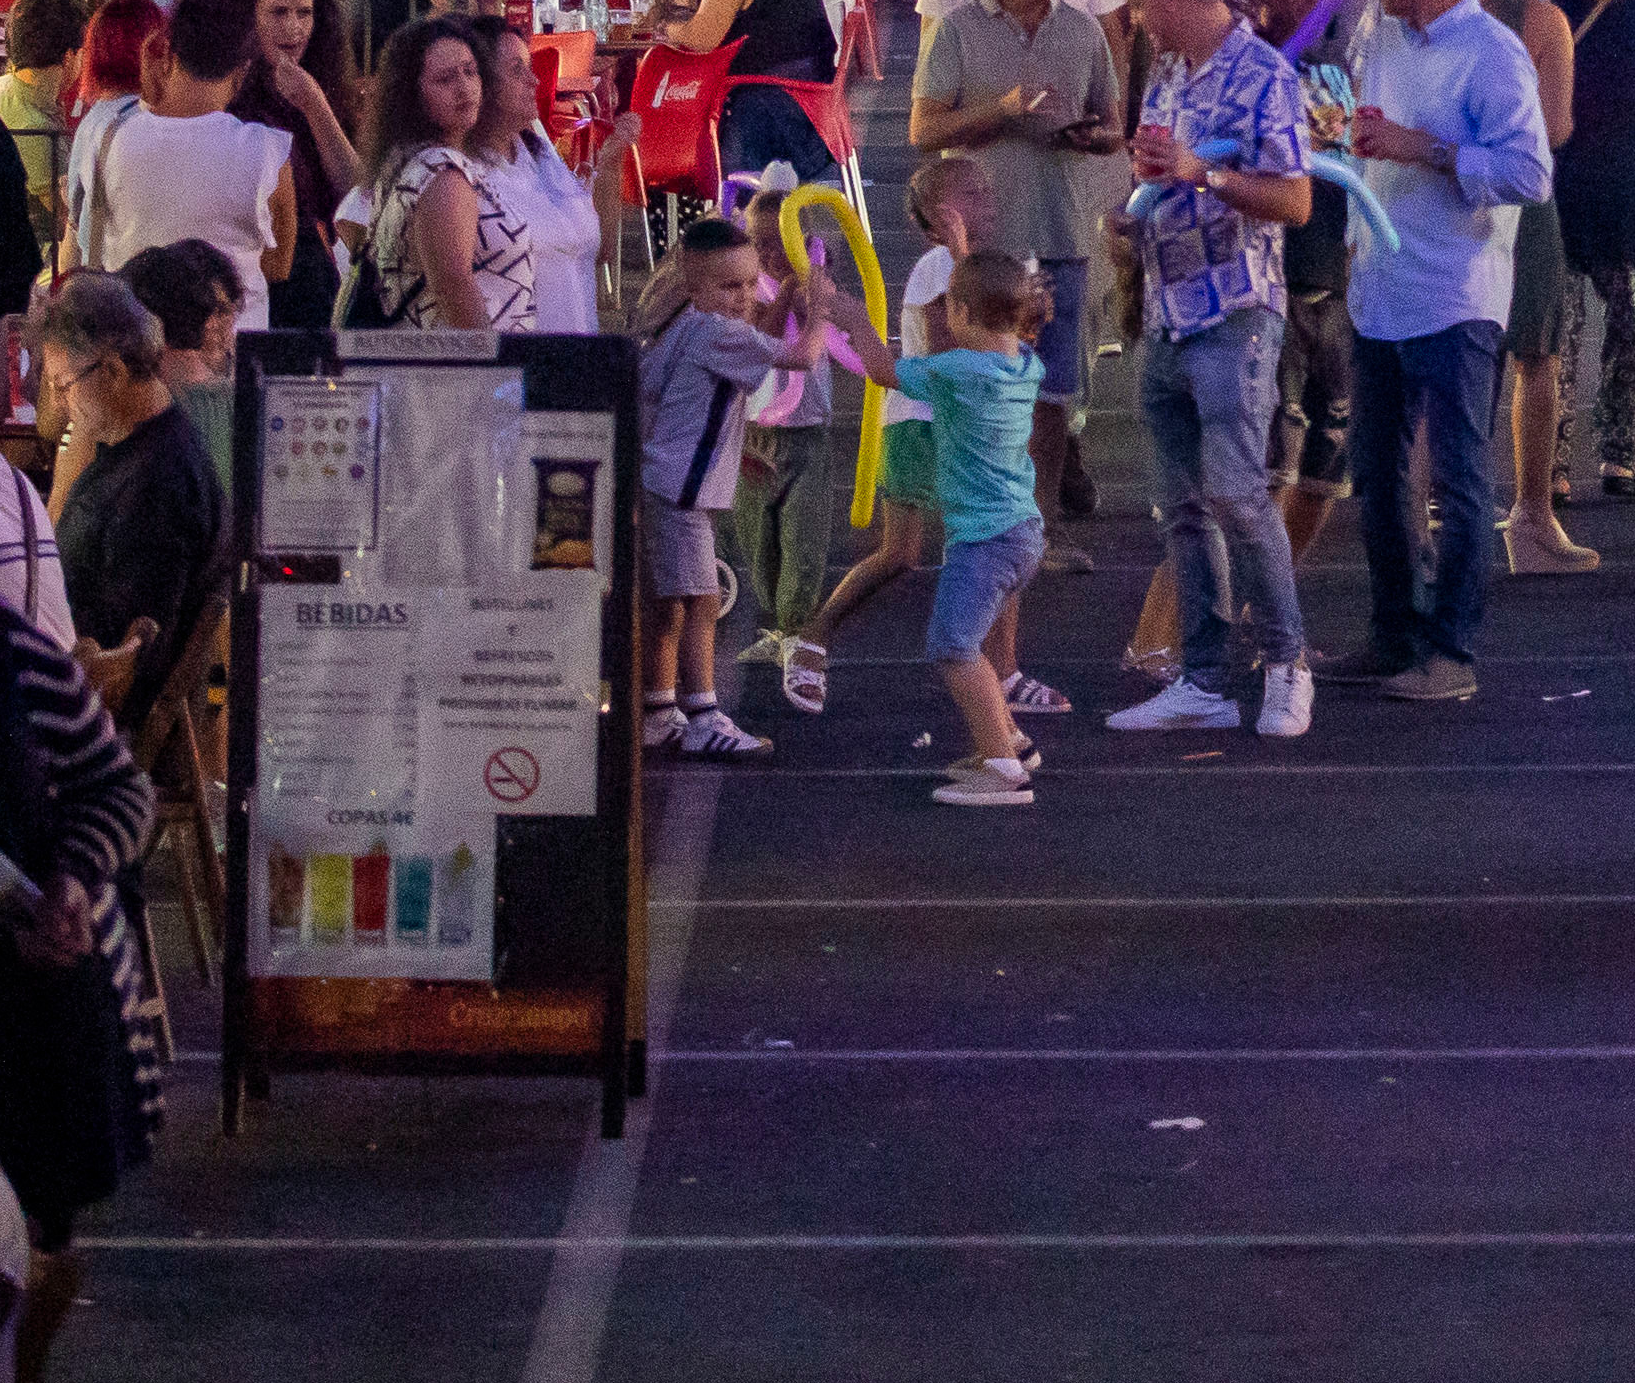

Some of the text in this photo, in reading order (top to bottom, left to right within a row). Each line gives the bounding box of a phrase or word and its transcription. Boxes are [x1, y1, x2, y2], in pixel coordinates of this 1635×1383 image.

[296, 601, 409, 628] BEBIDAS
[437, 697, 579, 711] PROHIBIDO FUMAR
[326, 808, 414, 827] COPAS 4€
